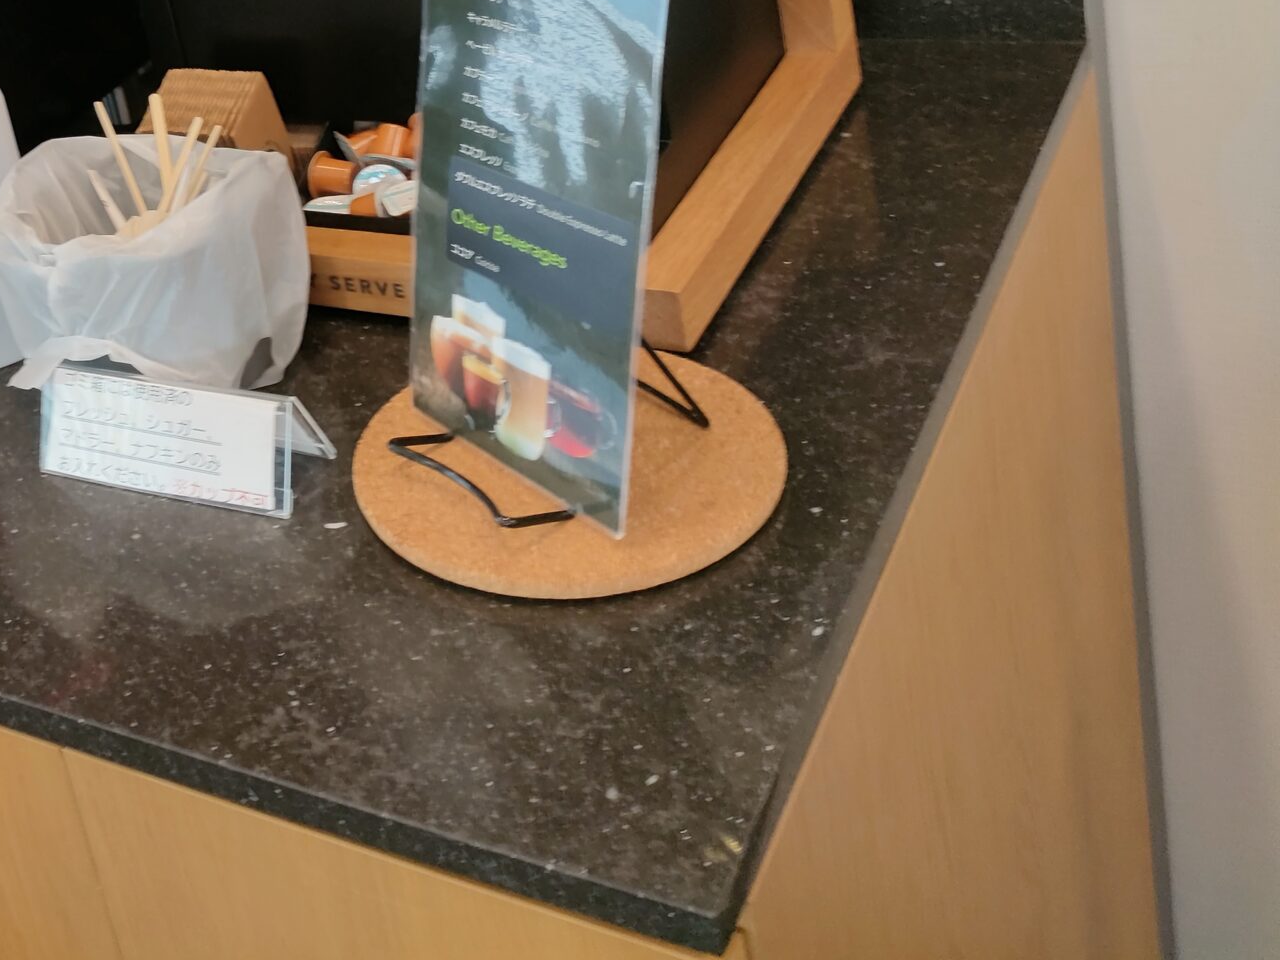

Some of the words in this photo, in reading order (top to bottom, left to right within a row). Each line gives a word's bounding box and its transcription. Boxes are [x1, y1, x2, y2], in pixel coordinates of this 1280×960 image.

[450, 207, 492, 237] Other
[492, 224, 568, 270] Beverages
[328, 274, 406, 299] SERVE
